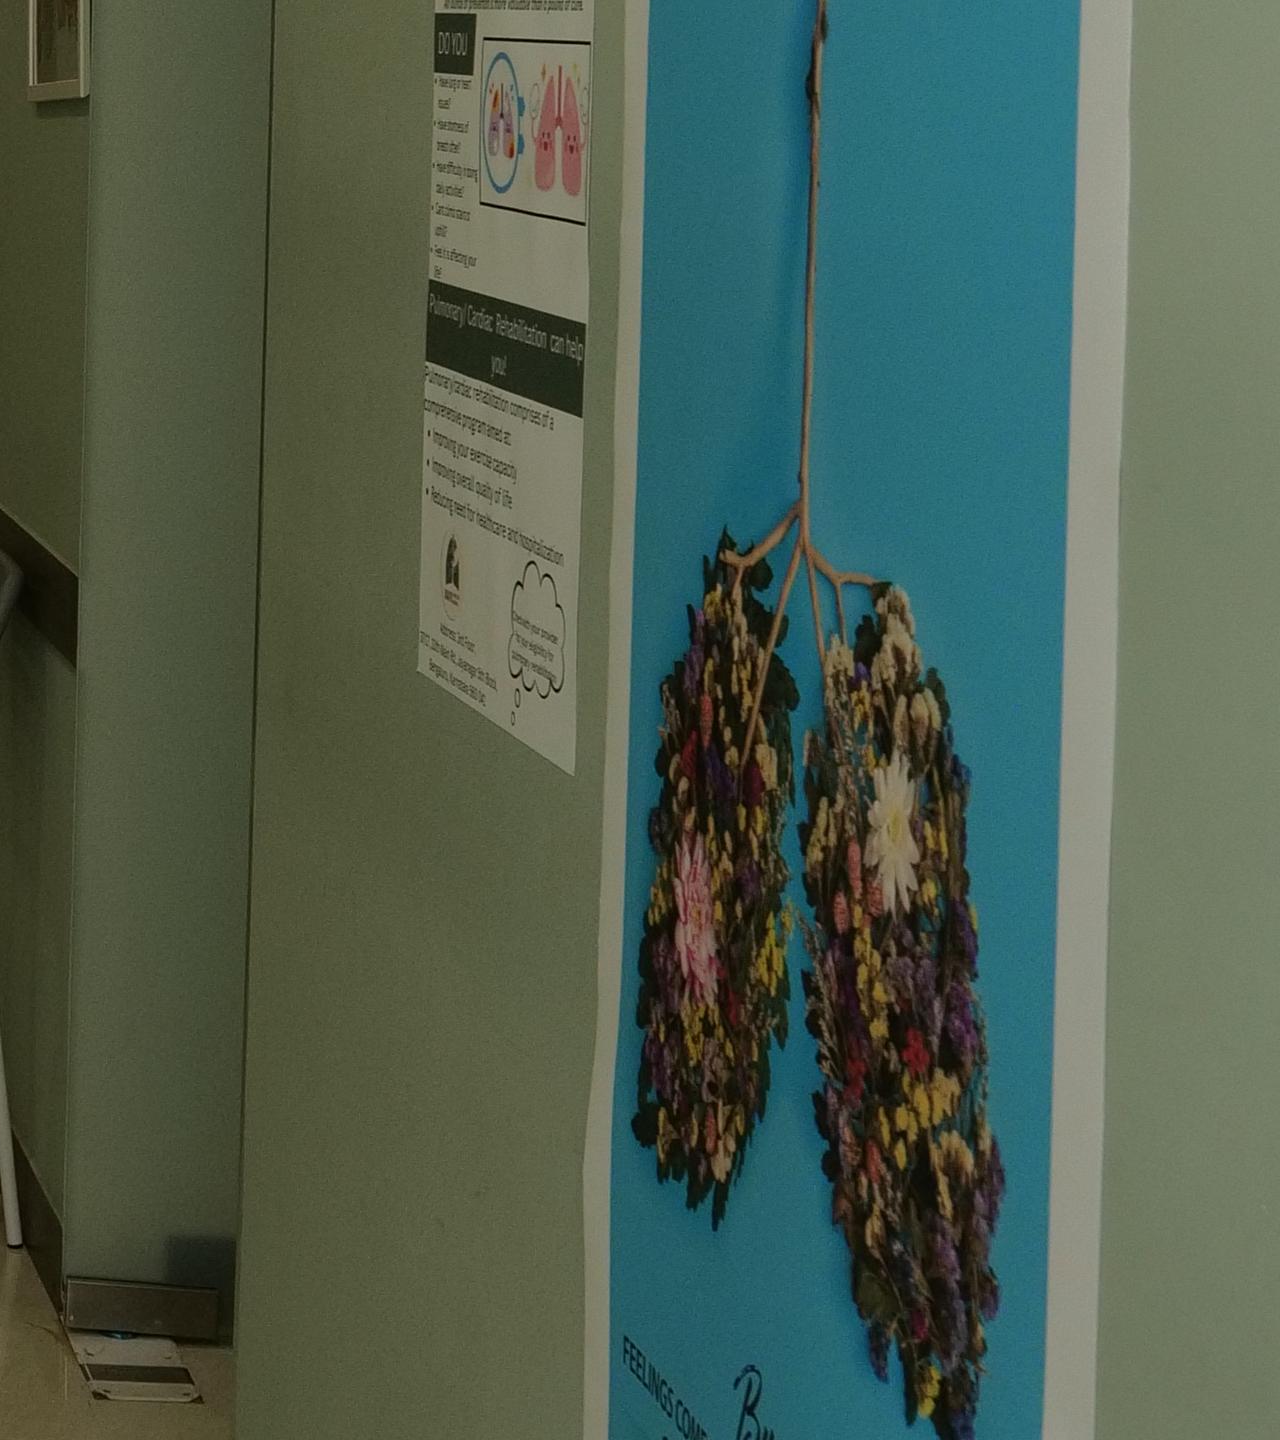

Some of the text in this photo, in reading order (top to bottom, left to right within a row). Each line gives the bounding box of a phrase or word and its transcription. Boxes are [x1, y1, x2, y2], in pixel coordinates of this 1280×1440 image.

[437, 31, 468, 56] DO YOU
[467, 304, 493, 332] Cardiac
[495, 312, 547, 348] Rehabilitation
[549, 334, 564, 354] can
[565, 333, 584, 366] help
[622, 1334, 674, 1418] FEELINGS
